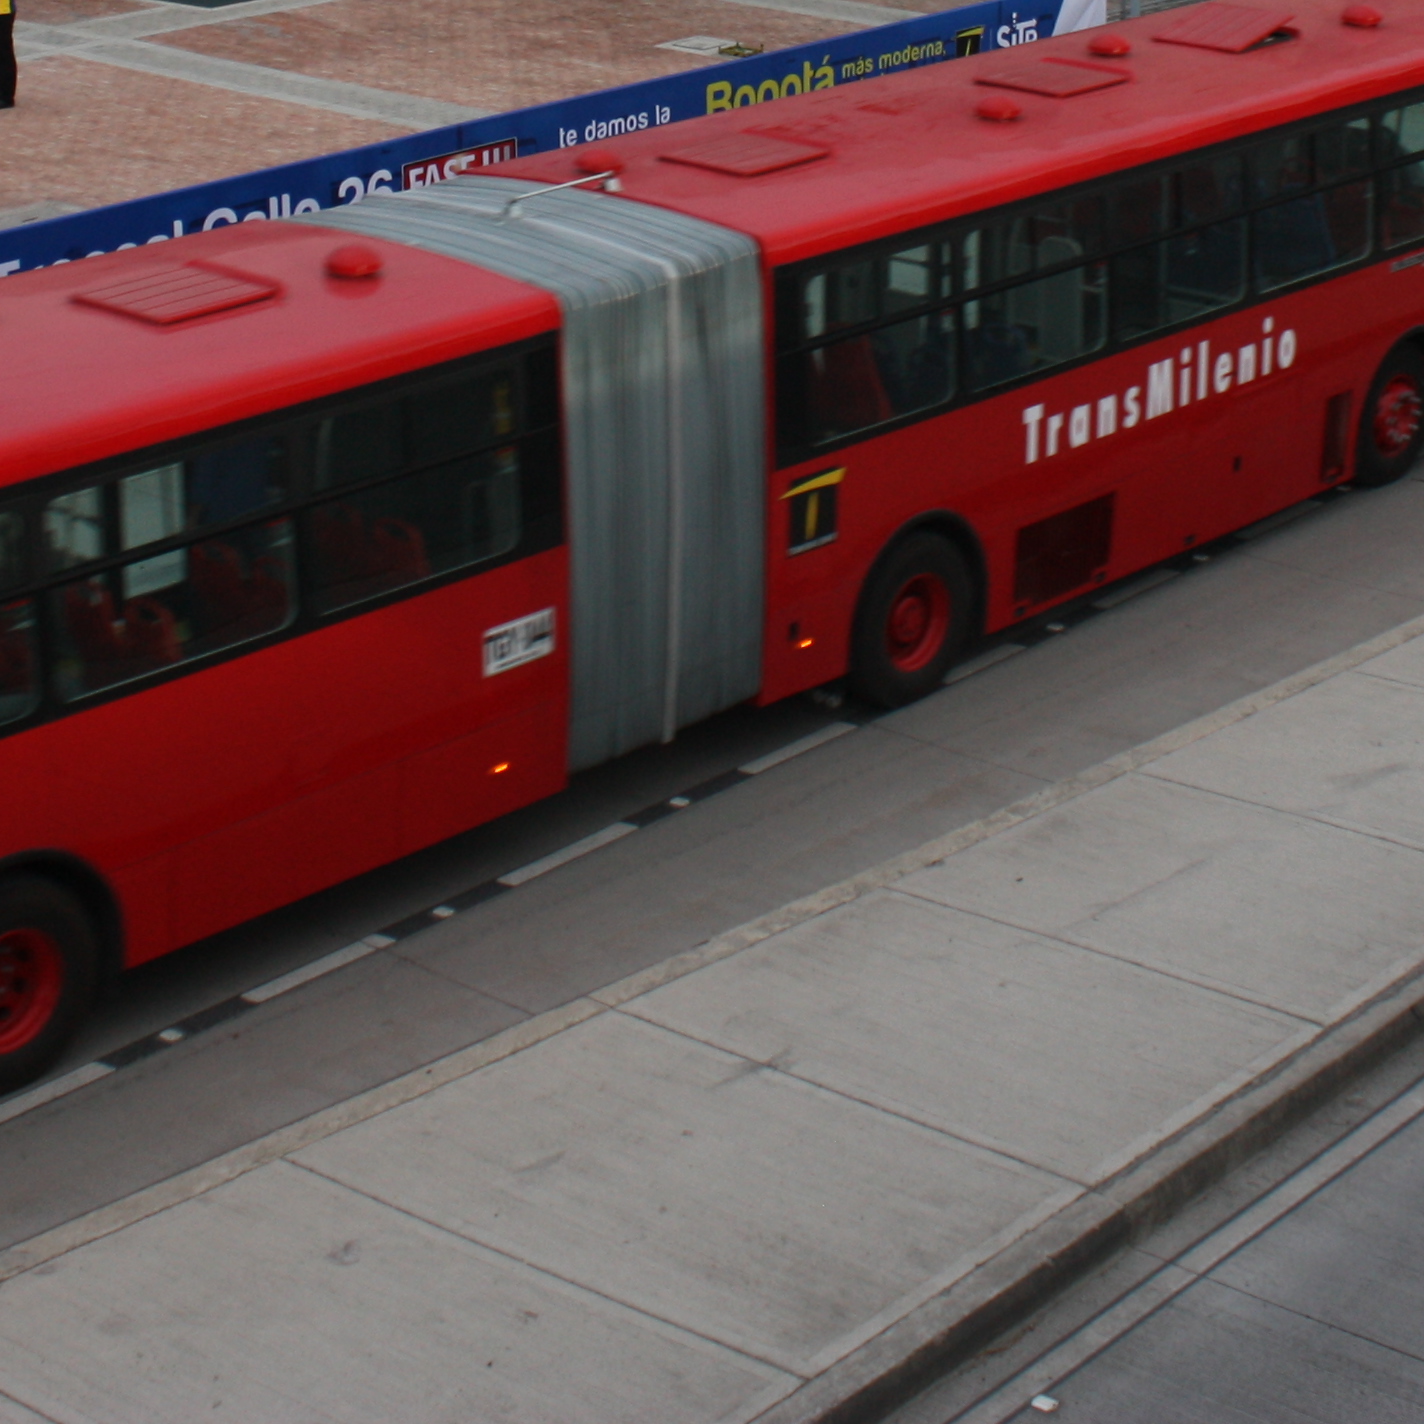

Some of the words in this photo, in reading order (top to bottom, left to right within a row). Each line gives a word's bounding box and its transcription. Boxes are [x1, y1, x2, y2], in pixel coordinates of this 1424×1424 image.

[841, 56, 874, 79] más
[878, 39, 947, 70] moderna,
[560, 128, 577, 149] te
[584, 109, 649, 142] damos
[655, 104, 671, 125] la
[1022, 316, 1297, 465] TransMilenio
